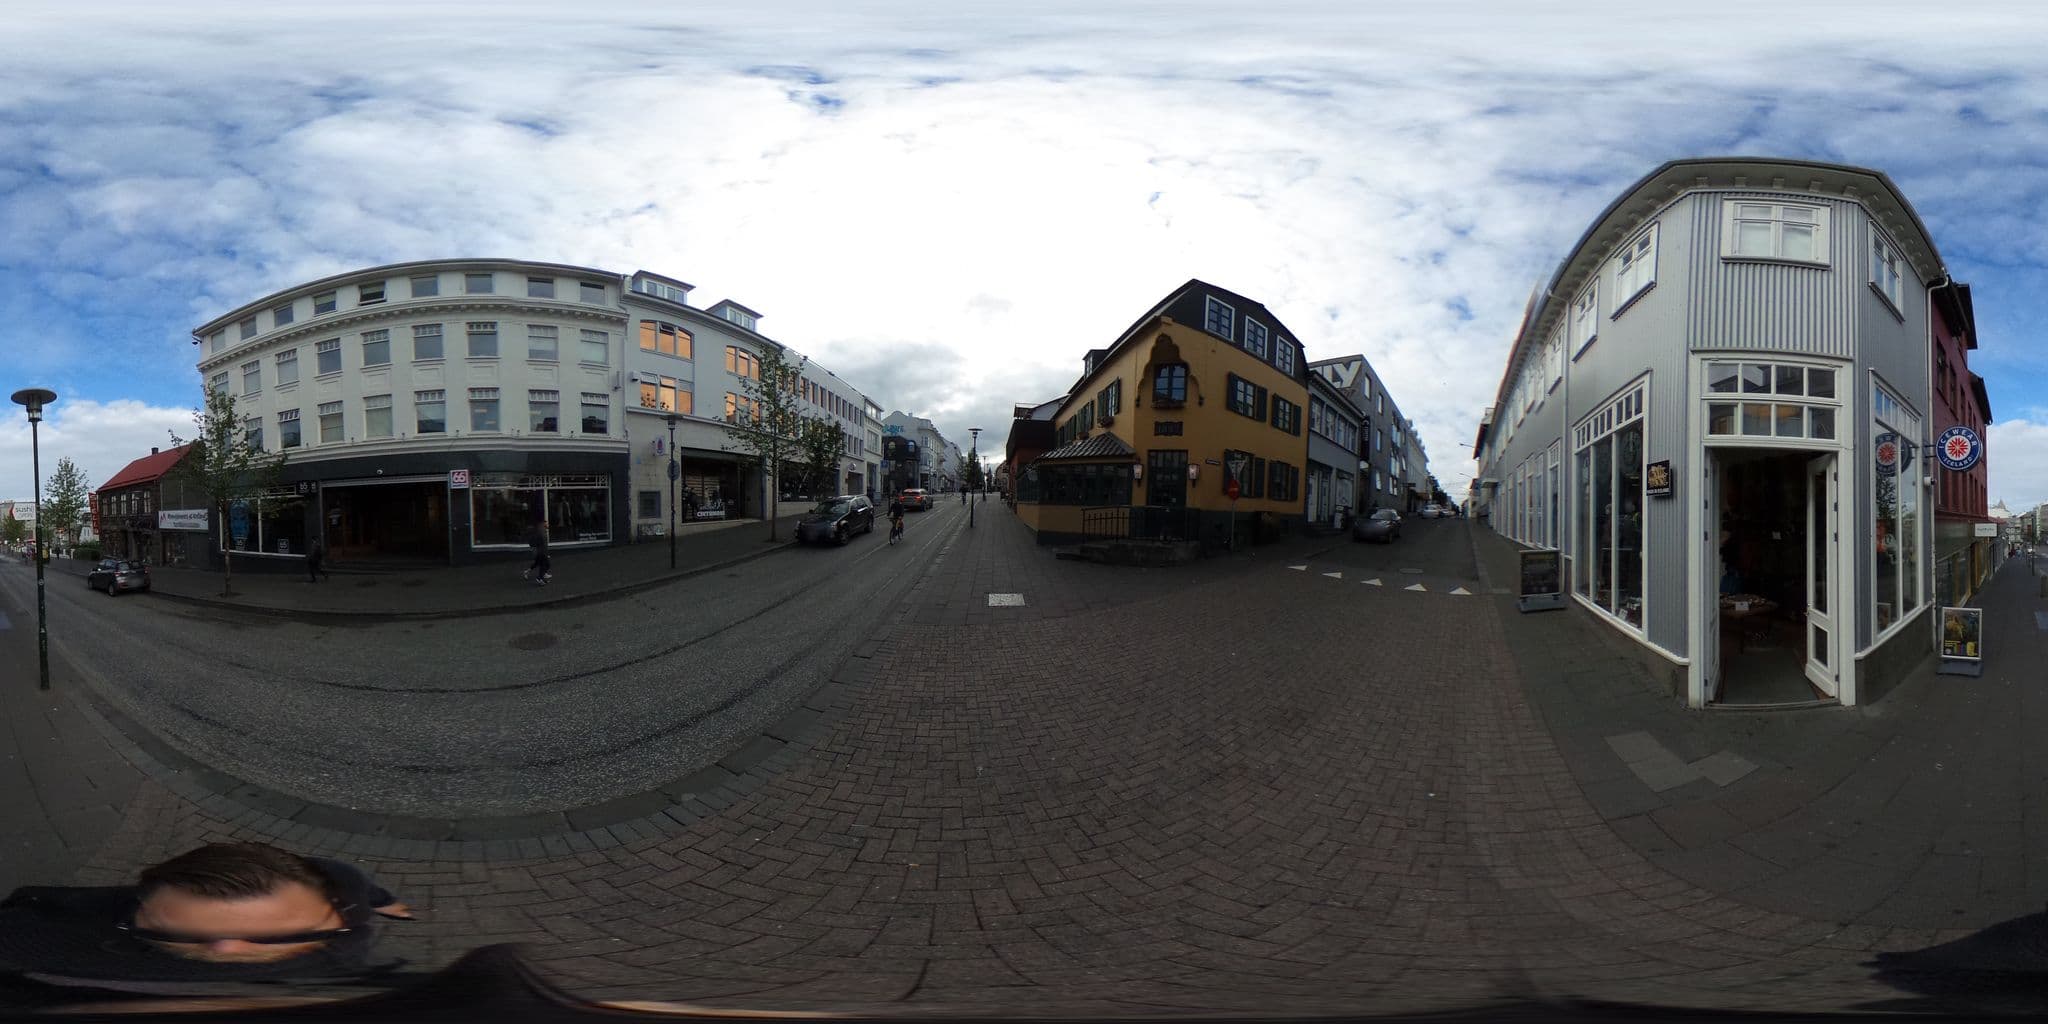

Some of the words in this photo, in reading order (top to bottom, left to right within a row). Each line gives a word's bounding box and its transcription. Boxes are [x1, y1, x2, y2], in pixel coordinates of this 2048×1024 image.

[1939, 429, 1978, 449] ICEWEAR
[1943, 456, 1974, 467] ICELAND
[453, 472, 466, 483] 66
